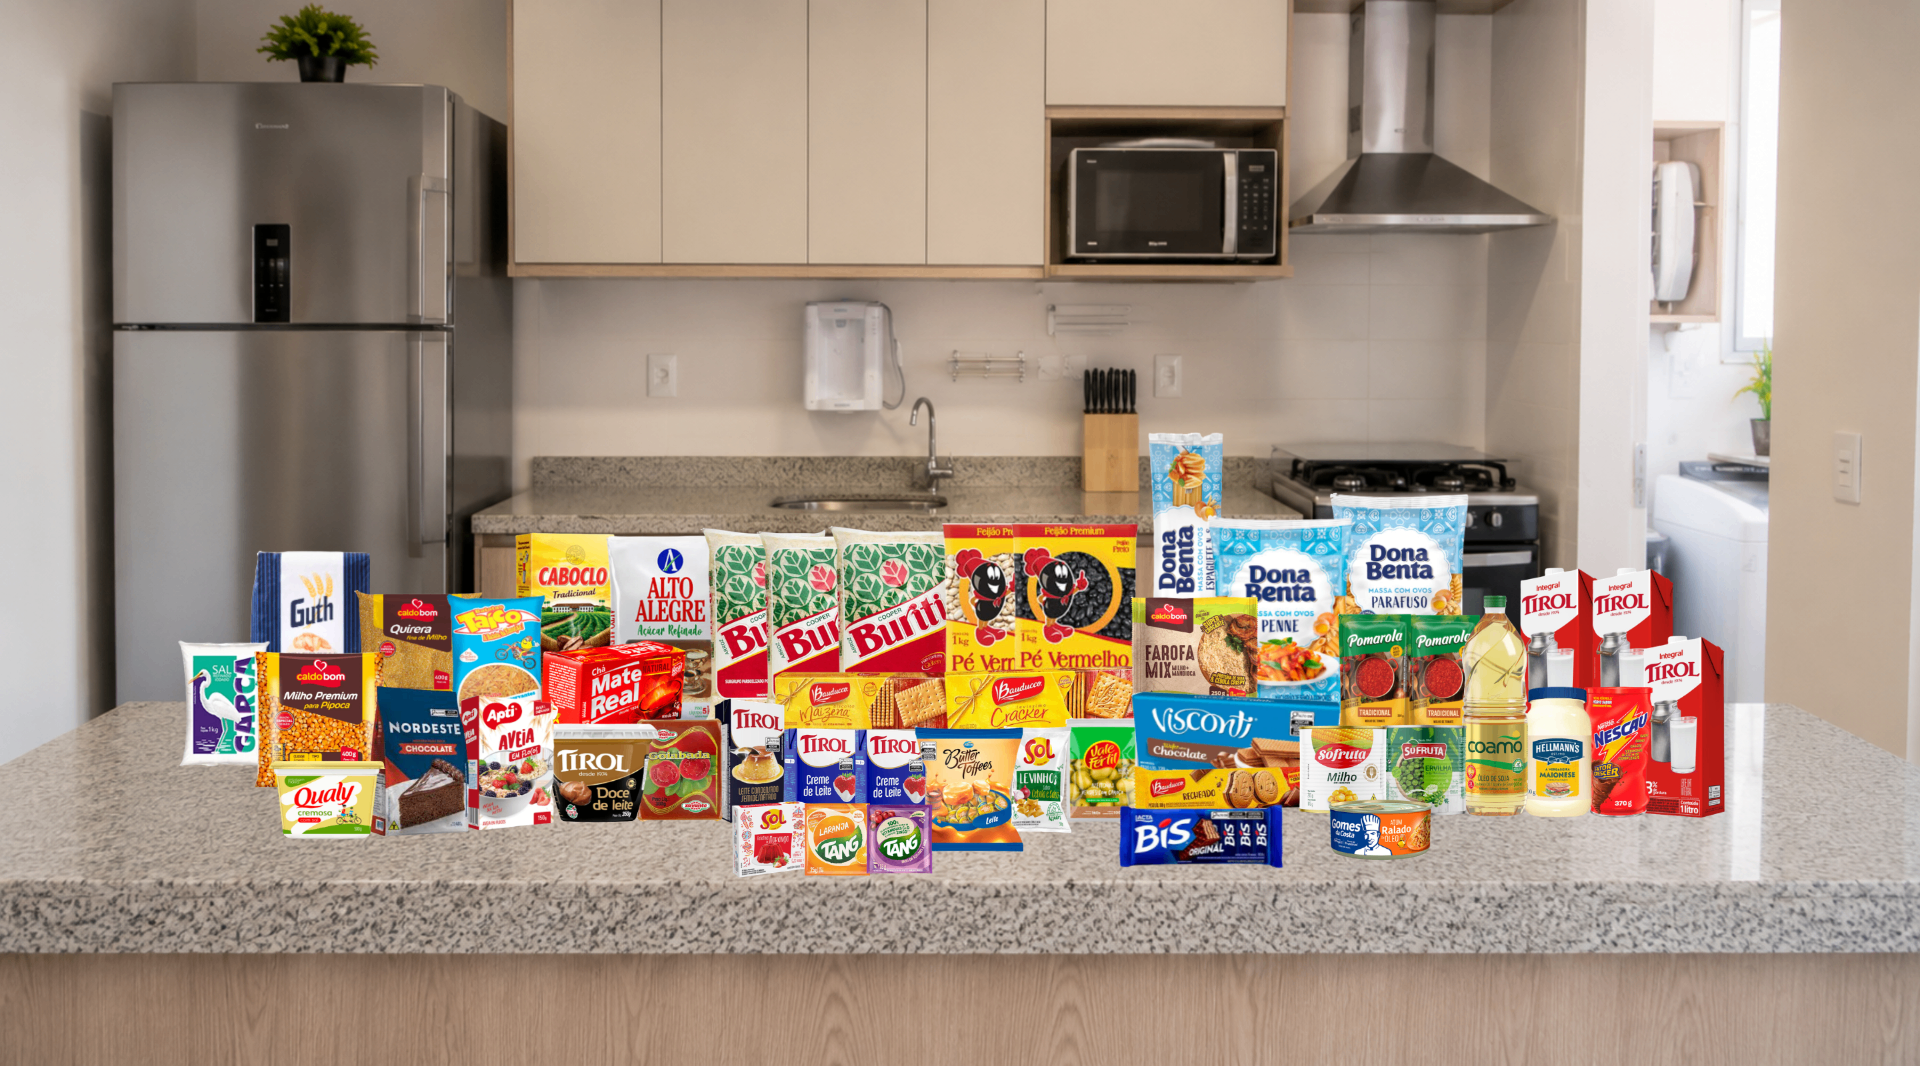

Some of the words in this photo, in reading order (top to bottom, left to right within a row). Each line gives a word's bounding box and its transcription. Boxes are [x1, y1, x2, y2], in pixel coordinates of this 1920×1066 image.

[977, 528, 1000, 538] Feijão
[1045, 527, 1068, 537] Feijão
[1158, 530, 1176, 590] Dona
[1176, 525, 1195, 594] Benta
[1370, 545, 1429, 562] Dona
[539, 567, 607, 586] CABOCLO
[1249, 565, 1312, 583] Dona
[1366, 562, 1433, 581] Benta
[553, 588, 596, 599] Tradicional
[647, 577, 693, 599] ALTO
[1245, 584, 1316, 602] Benta
[1536, 581, 1560, 591] Integral
[1609, 581, 1632, 591] Integral
[1371, 596, 1428, 609] PARAFUSO
[1522, 594, 1576, 615] TIROL
[1594, 594, 1649, 615] TIROL
[290, 596, 333, 628] Guth
[635, 600, 705, 622] ALEGRE
[878, 608, 902, 621] COOPER
[806, 613, 830, 626] COOPER
[849, 594, 947, 658] Buriti
[1261, 619, 1299, 633] PENNE
[390, 624, 432, 635] Quirera
[637, 625, 665, 636] Açúcar
[668, 625, 702, 638] Refinado
[1348, 629, 1403, 647] Pomarola
[1021, 650, 1043, 668] Pé
[1048, 650, 1129, 668] Vermelho
[1145, 645, 1194, 661] FAROFA
[1659, 650, 1683, 659] Integral
[213, 665, 229, 674] SAL
[643, 664, 669, 673] NATURAL
[952, 653, 974, 671] Pé
[1145, 662, 1171, 678] MIX
[592, 665, 606, 676] Chá
[1645, 662, 1699, 683] TIROL
[592, 669, 642, 696] Mate
[284, 692, 312, 700] Milho
[315, 692, 357, 700] Premium
[995, 681, 1042, 701] Bauducco
[321, 702, 350, 710] Pipoca
[591, 683, 639, 719] Real
[487, 705, 515, 722] Apti
[733, 709, 783, 731] TIROL
[991, 707, 1048, 727] Cracker
[389, 721, 461, 734] NORDESTE
[1152, 708, 1254, 738] Visconti
[1594, 712, 1648, 748] NESCAU
[499, 728, 534, 750] AVEIA
[800, 735, 850, 754] TIROL
[870, 736, 920, 755] TIROL
[1468, 741, 1522, 753] coamo
[649, 751, 710, 760] Goiabada
[1023, 739, 1055, 764] Sol
[1091, 744, 1115, 757] Vale
[1153, 746, 1207, 760] Chocolate
[1536, 743, 1579, 753] HELLMANN'S
[557, 749, 629, 772] TIROL
[943, 749, 980, 769] Butter
[1089, 753, 1117, 769] Fértil
[958, 761, 992, 779] Toffees
[1327, 772, 1357, 781] Milho
[806, 775, 829, 785] Creme
[876, 776, 899, 786] Creme
[294, 782, 354, 808] Qualy
[597, 787, 629, 798] Doce
[804, 785, 814, 796] de
[815, 786, 831, 796] Leite
[873, 787, 883, 797] de
[885, 787, 901, 797] Leite
[1183, 790, 1215, 800] RECHEADO
[593, 801, 608, 810] de
[613, 800, 633, 810] leite
[760, 810, 786, 830] Sol
[986, 816, 998, 825] Leite
[1332, 819, 1360, 832] Gomes
[819, 822, 849, 836] LARANJA
[1382, 825, 1411, 834] Ralado
[821, 835, 858, 860] TANG
[884, 834, 918, 857] TANG
[1189, 843, 1224, 856] ORIGINAL
